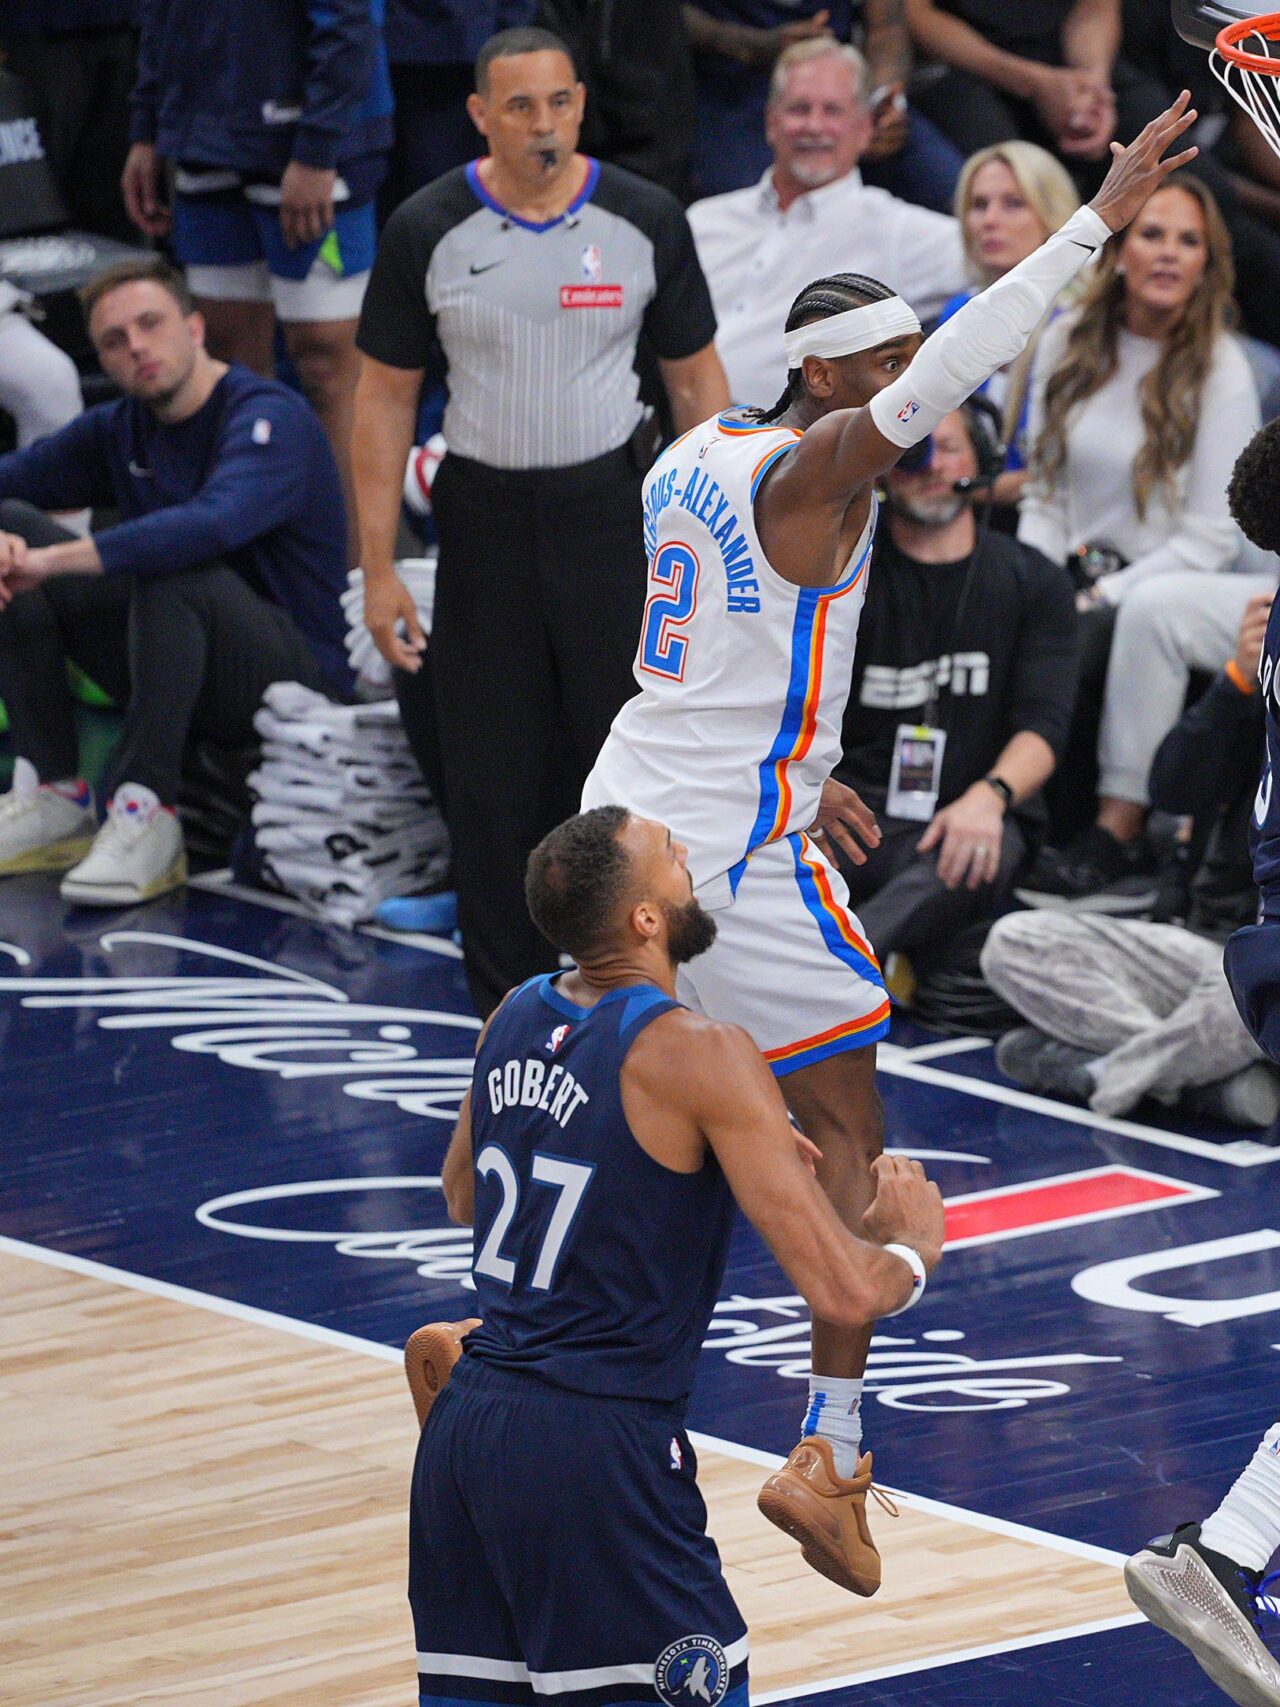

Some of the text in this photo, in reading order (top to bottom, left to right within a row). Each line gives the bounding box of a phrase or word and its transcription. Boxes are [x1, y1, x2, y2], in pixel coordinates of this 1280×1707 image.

[640, 540, 701, 683] 2
[859, 651, 990, 710] ESPN
[487, 1058, 590, 1129] GOBERT
[474, 1143, 595, 1292] 27
[657, 1639, 727, 1695] MINNESOTA TIMBERWOLVES
